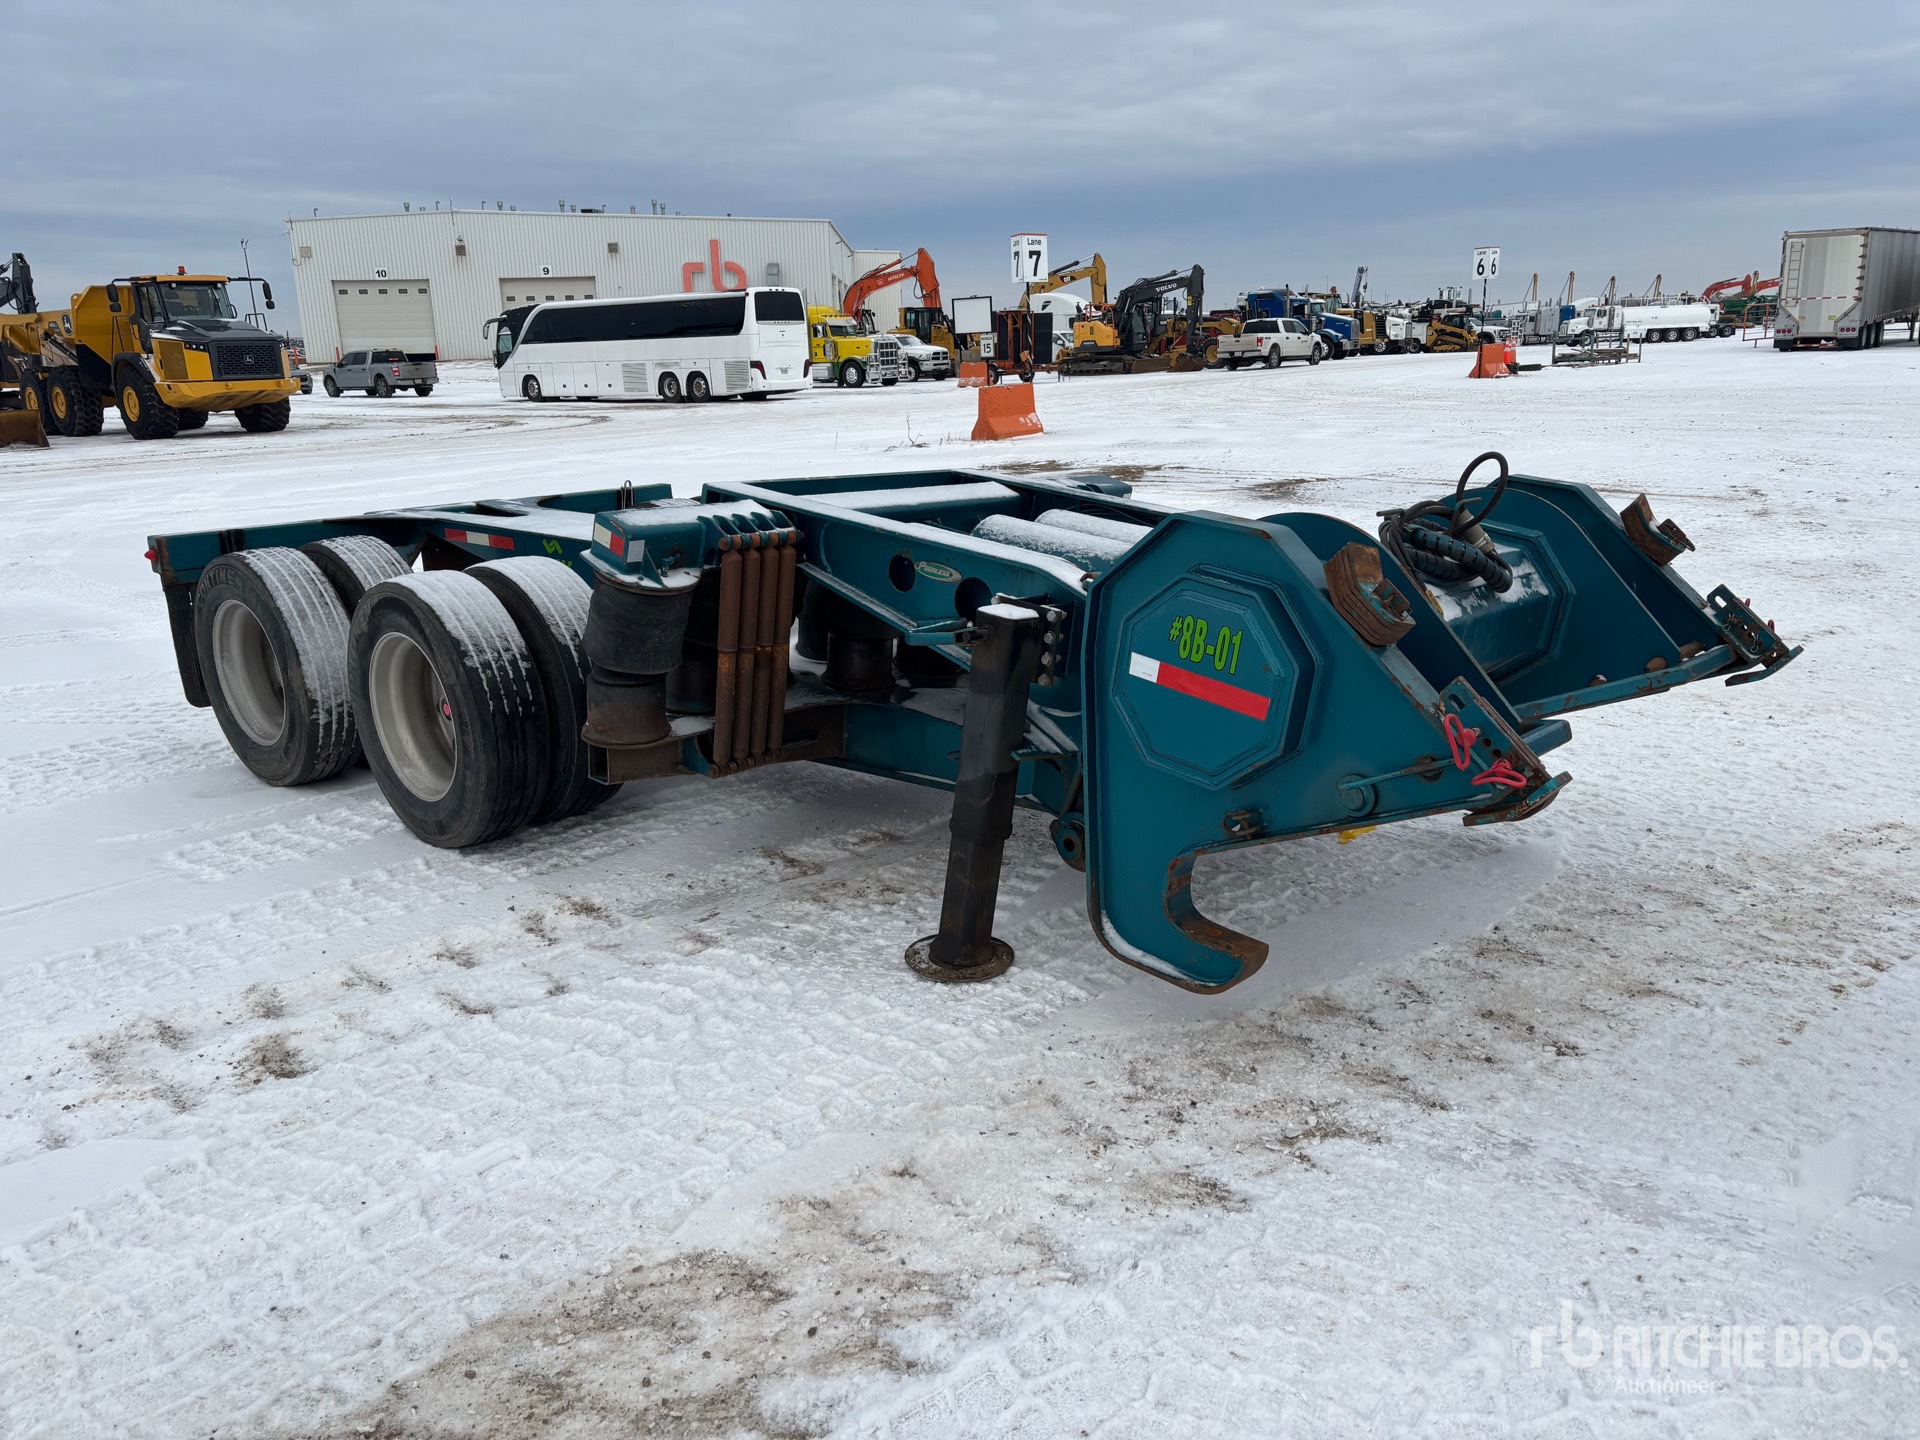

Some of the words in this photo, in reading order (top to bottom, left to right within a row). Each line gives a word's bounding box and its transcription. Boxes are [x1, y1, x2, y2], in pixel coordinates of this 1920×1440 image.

[1027, 237, 1042, 246] Lane
[543, 266, 550, 276] 9
[1013, 250, 1019, 277] 7
[1028, 250, 1042, 277] 7
[1477, 258, 1485, 276] 6
[1491, 257, 1497, 275] 6
[375, 268, 388, 279] 10
[1155, 282, 1177, 292] VOLVO
[983, 342, 992, 354] 15
[1167, 614, 1243, 675] #8B-01
